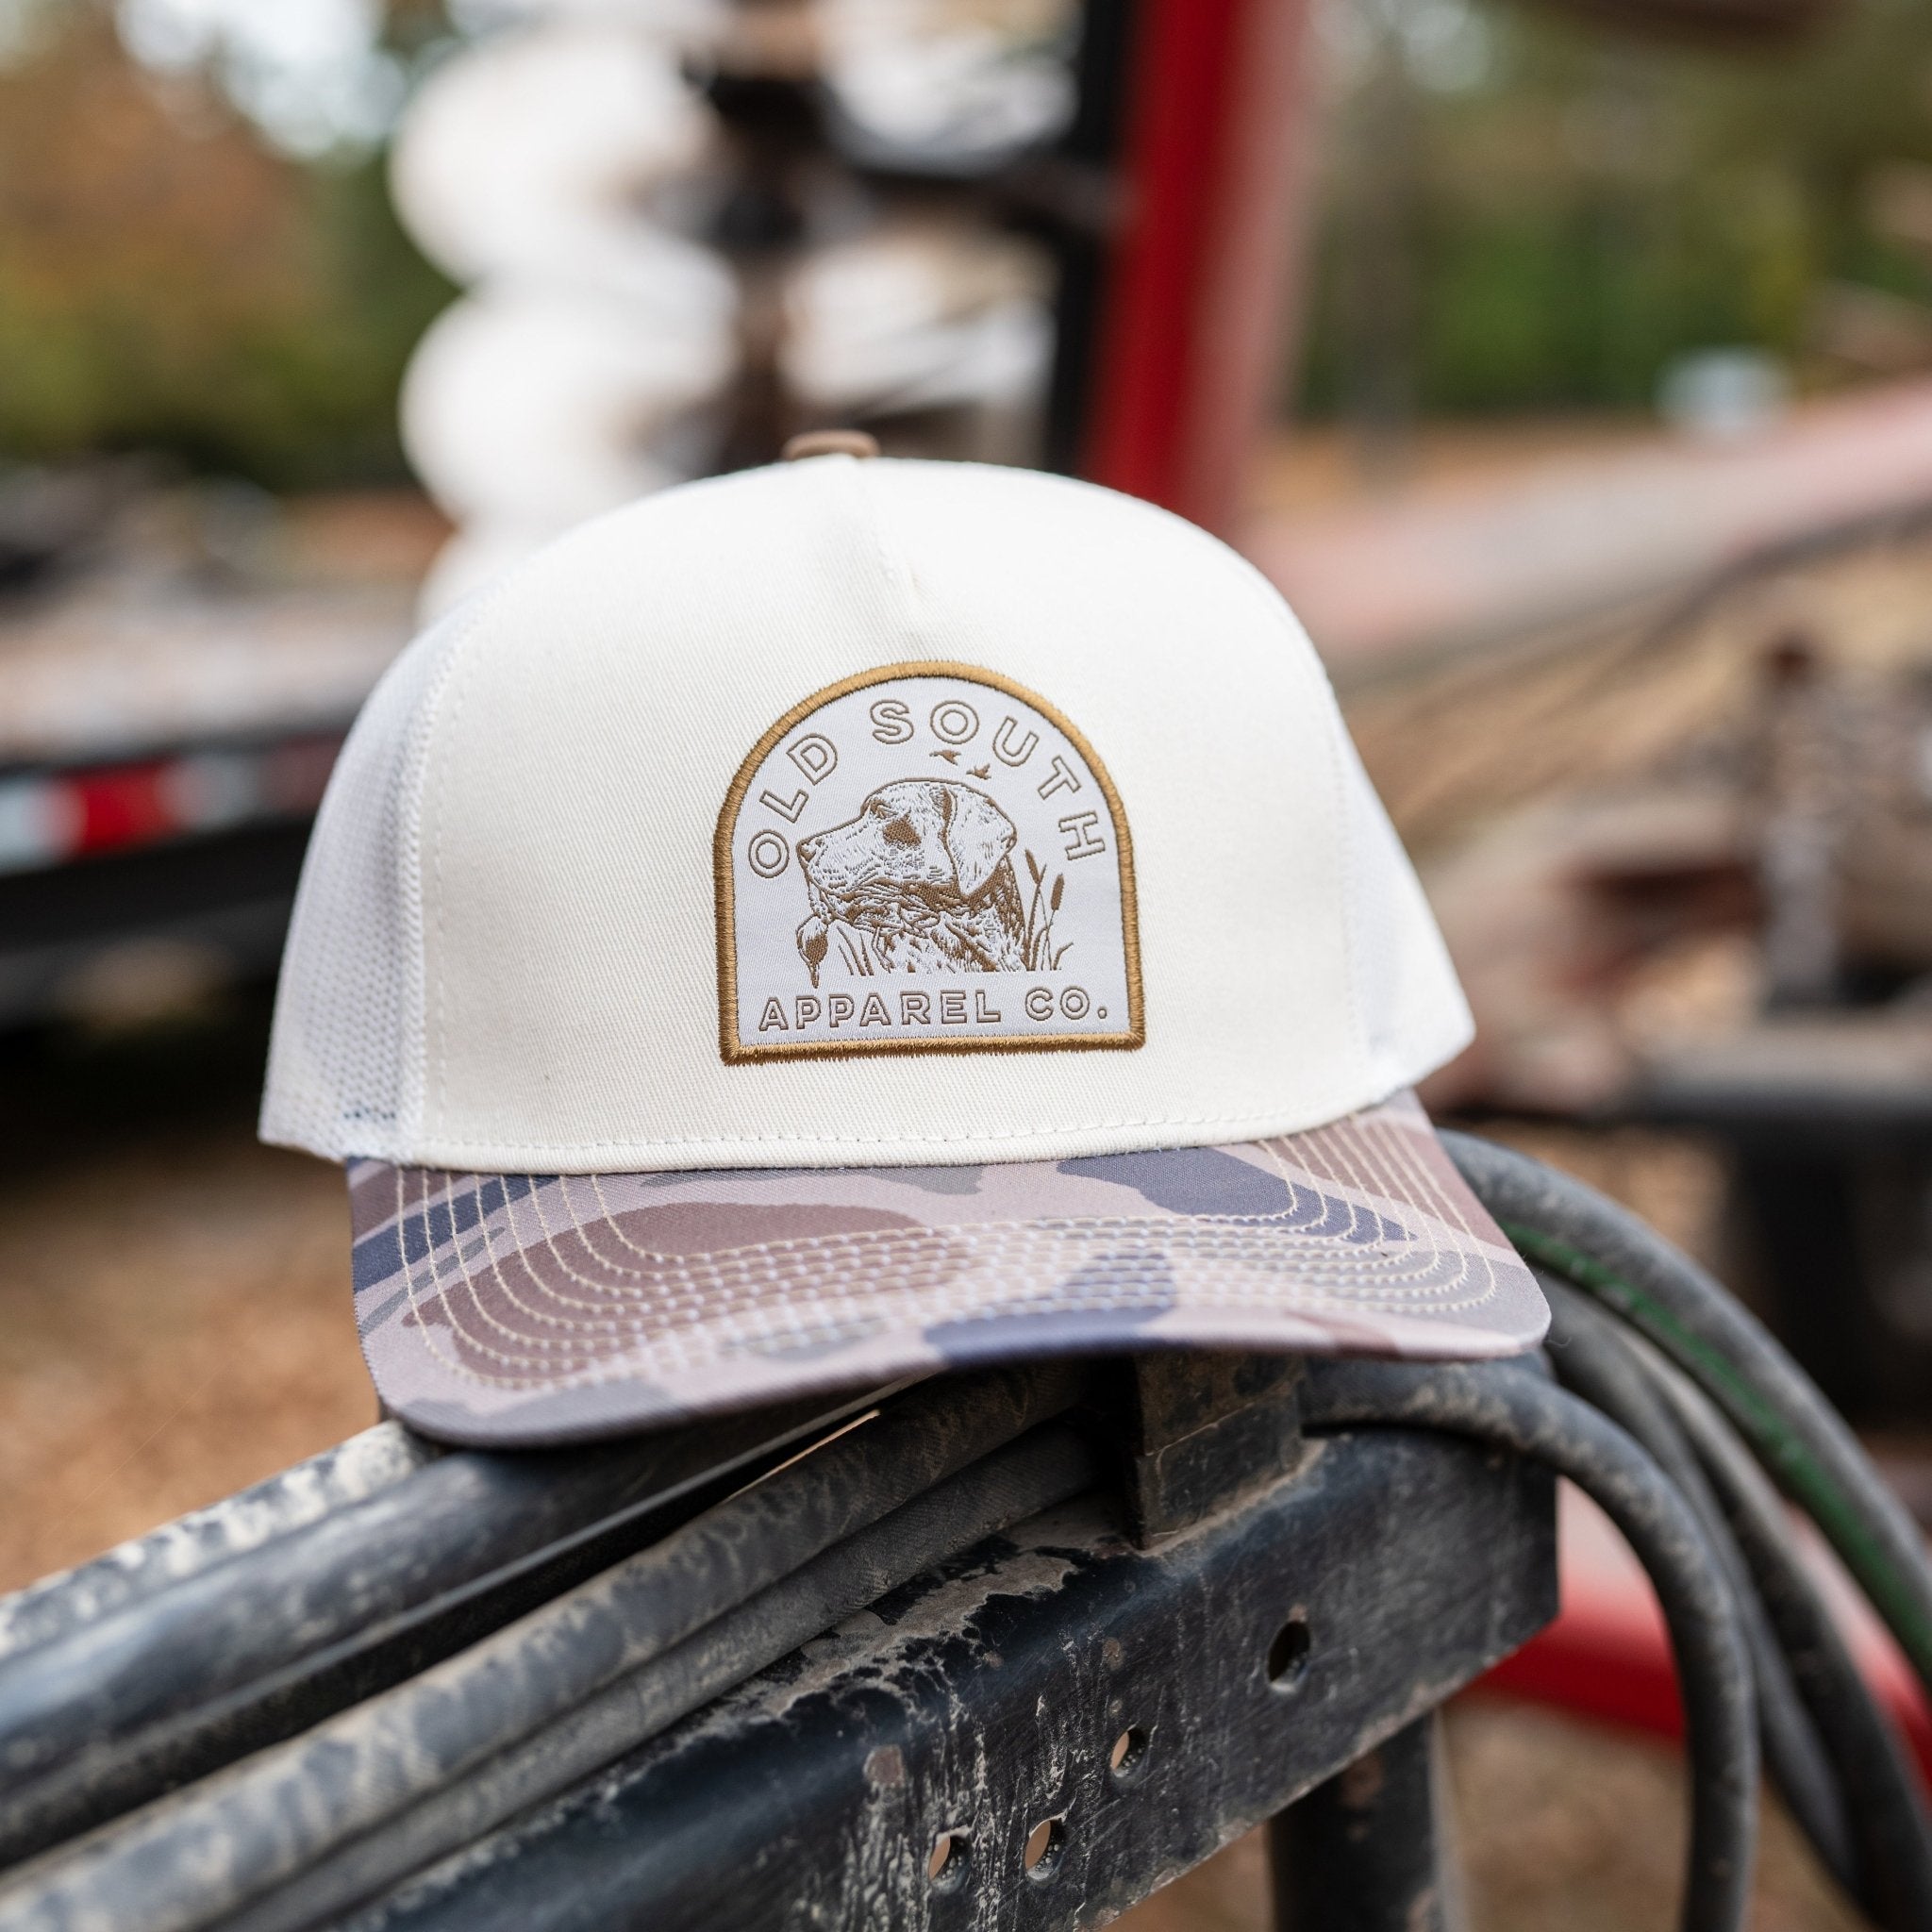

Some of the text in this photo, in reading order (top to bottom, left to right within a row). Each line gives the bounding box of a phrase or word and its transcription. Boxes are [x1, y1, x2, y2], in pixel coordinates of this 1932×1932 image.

[748, 699, 1106, 879] OLD SOUTH
[758, 986, 1108, 1032] APPAREL CO.
